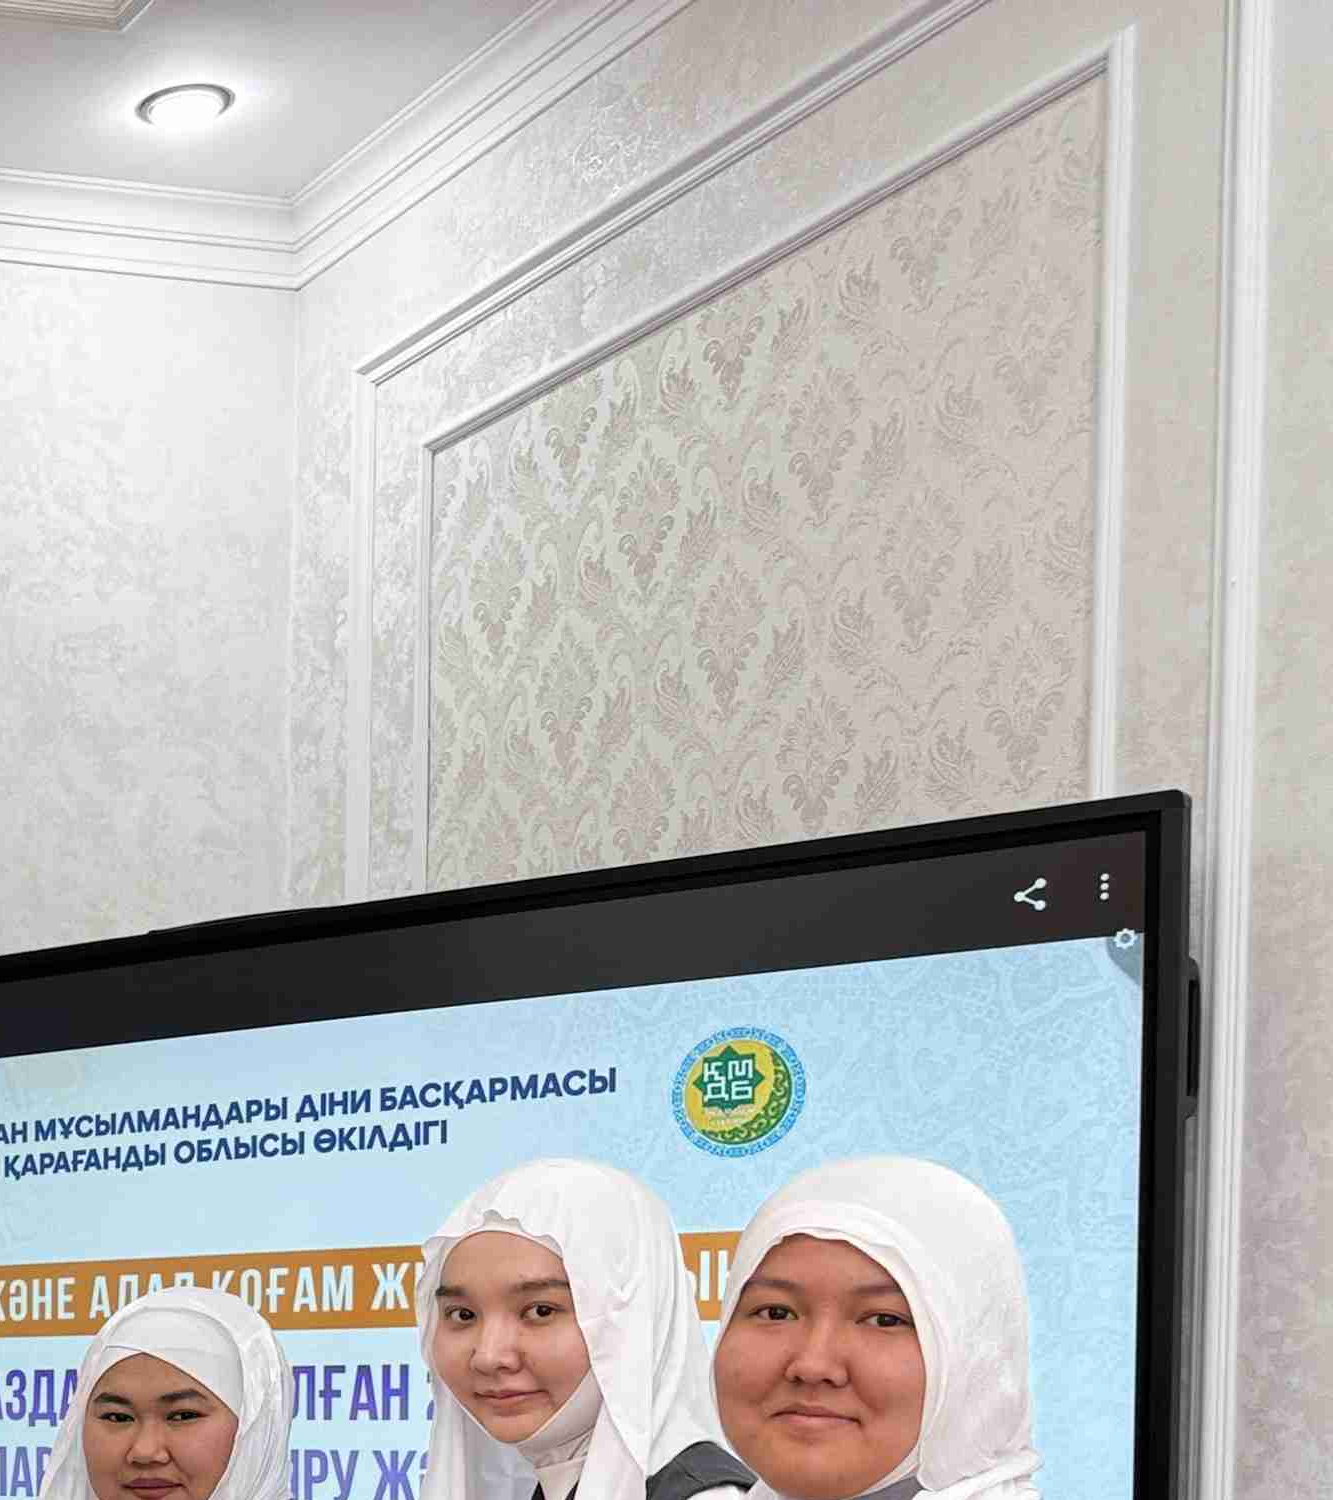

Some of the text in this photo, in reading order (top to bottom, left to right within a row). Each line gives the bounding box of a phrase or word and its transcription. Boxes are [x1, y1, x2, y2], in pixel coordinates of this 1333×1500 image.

[34, 1097, 289, 1141] МҰСЫЛМАНДАРЫ
[295, 1089, 372, 1124] ДІНИ
[379, 1067, 617, 1113] БАСҚАРМАСЫ
[2, 1121, 448, 1180] ҚАРАҒАНДЫ ОБЛЫСЫ ӨКІЛДІГІ
